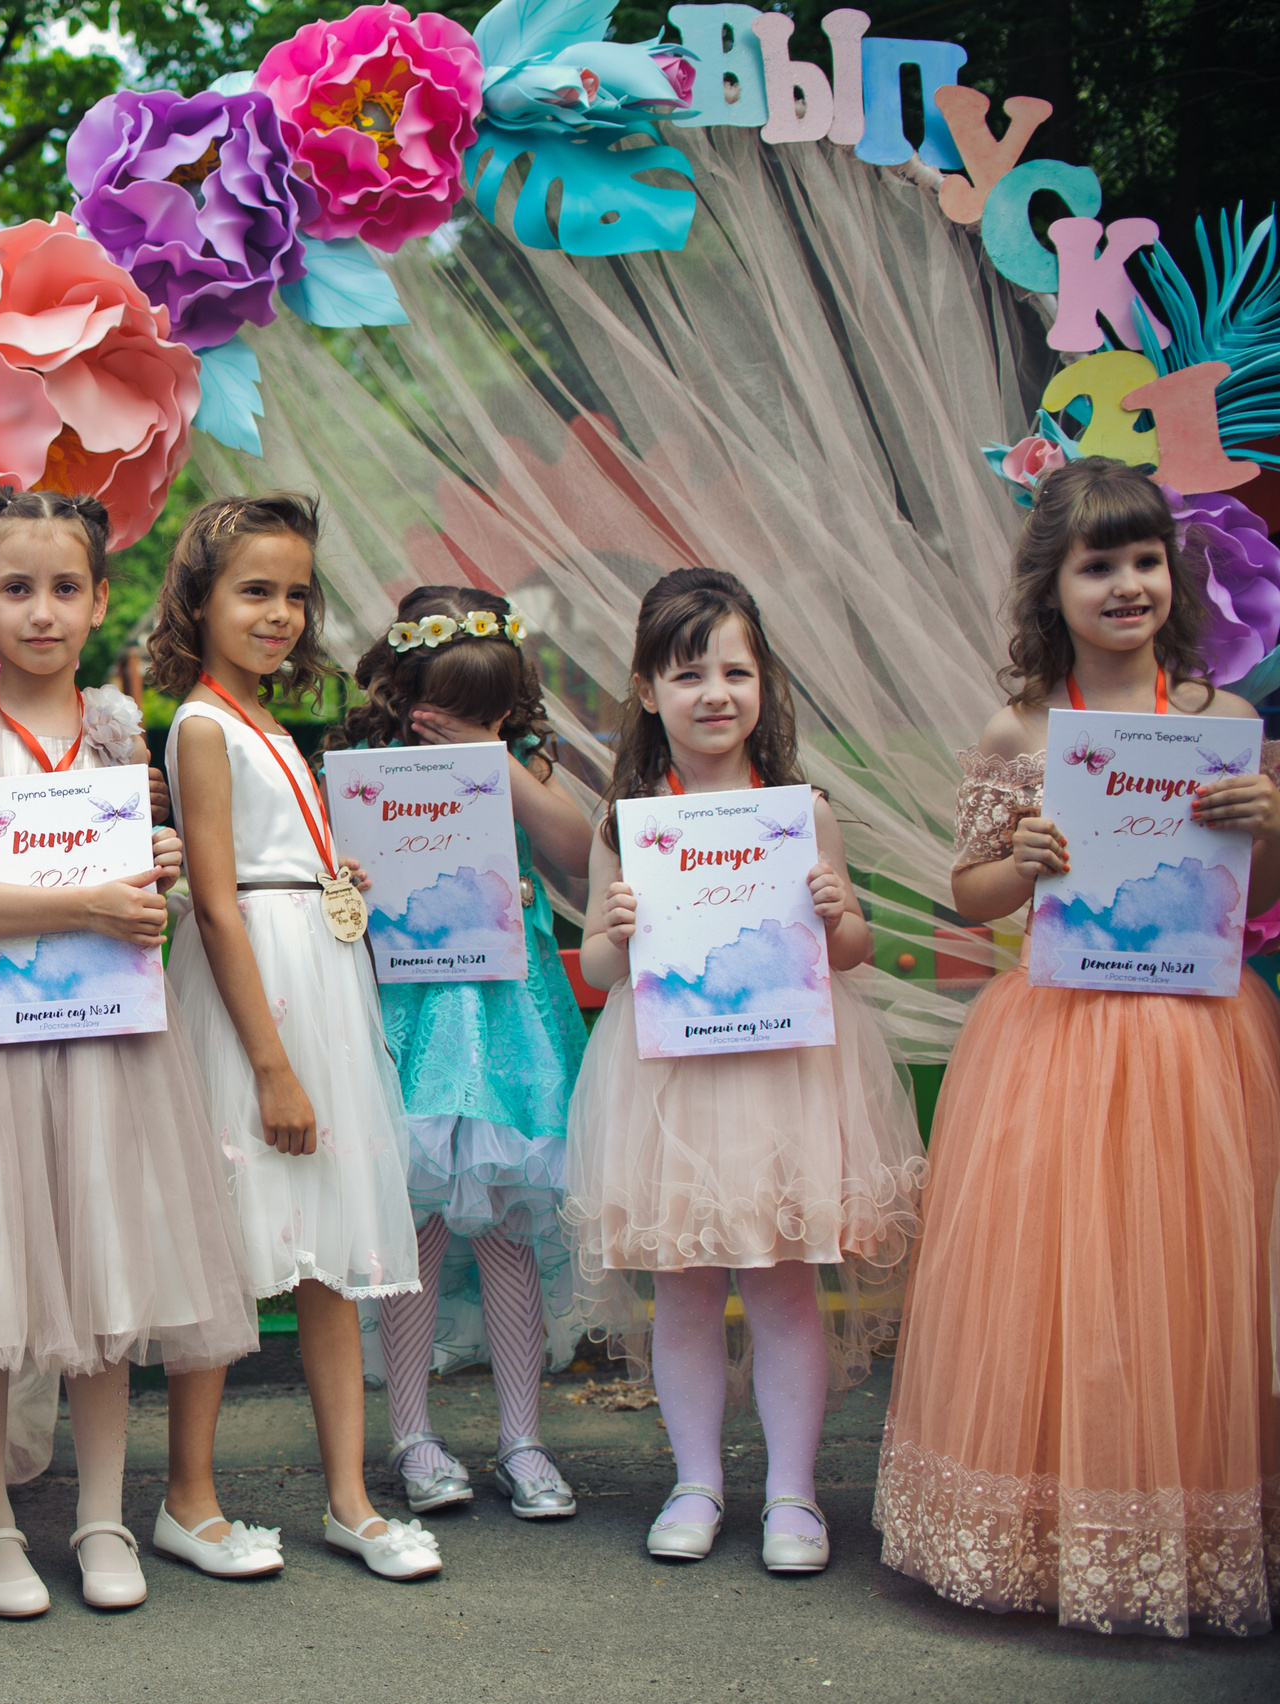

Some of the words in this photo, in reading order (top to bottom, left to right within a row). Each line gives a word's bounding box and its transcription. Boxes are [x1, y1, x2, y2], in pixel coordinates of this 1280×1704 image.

[668, 4, 1171, 352] ВЫПУСК
[1042, 351, 1261, 495] 21
[1114, 730, 1152, 742] Группа
[379, 765, 412, 775] Группа
[12, 790, 46, 802] Группа
[1106, 771, 1200, 802] Выпуск
[382, 800, 464, 822] Выпуск
[678, 810, 713, 820] Группа
[1114, 816, 1184, 837] 2021
[12, 828, 101, 854] Выпуск
[395, 834, 452, 853] 2021
[680, 847, 768, 871] Выпуск
[29, 866, 88, 887] 2021
[693, 884, 756, 906] 2021
[390, 957, 433, 968] Детский
[437, 957, 454, 967] сад
[1081, 958, 1134, 972] Детский
[1137, 962, 1157, 976] сад
[16, 1008, 64, 1024] Детский
[68, 1008, 86, 1020] сад
[685, 1023, 734, 1038] Детский
[737, 1022, 756, 1034] сад
